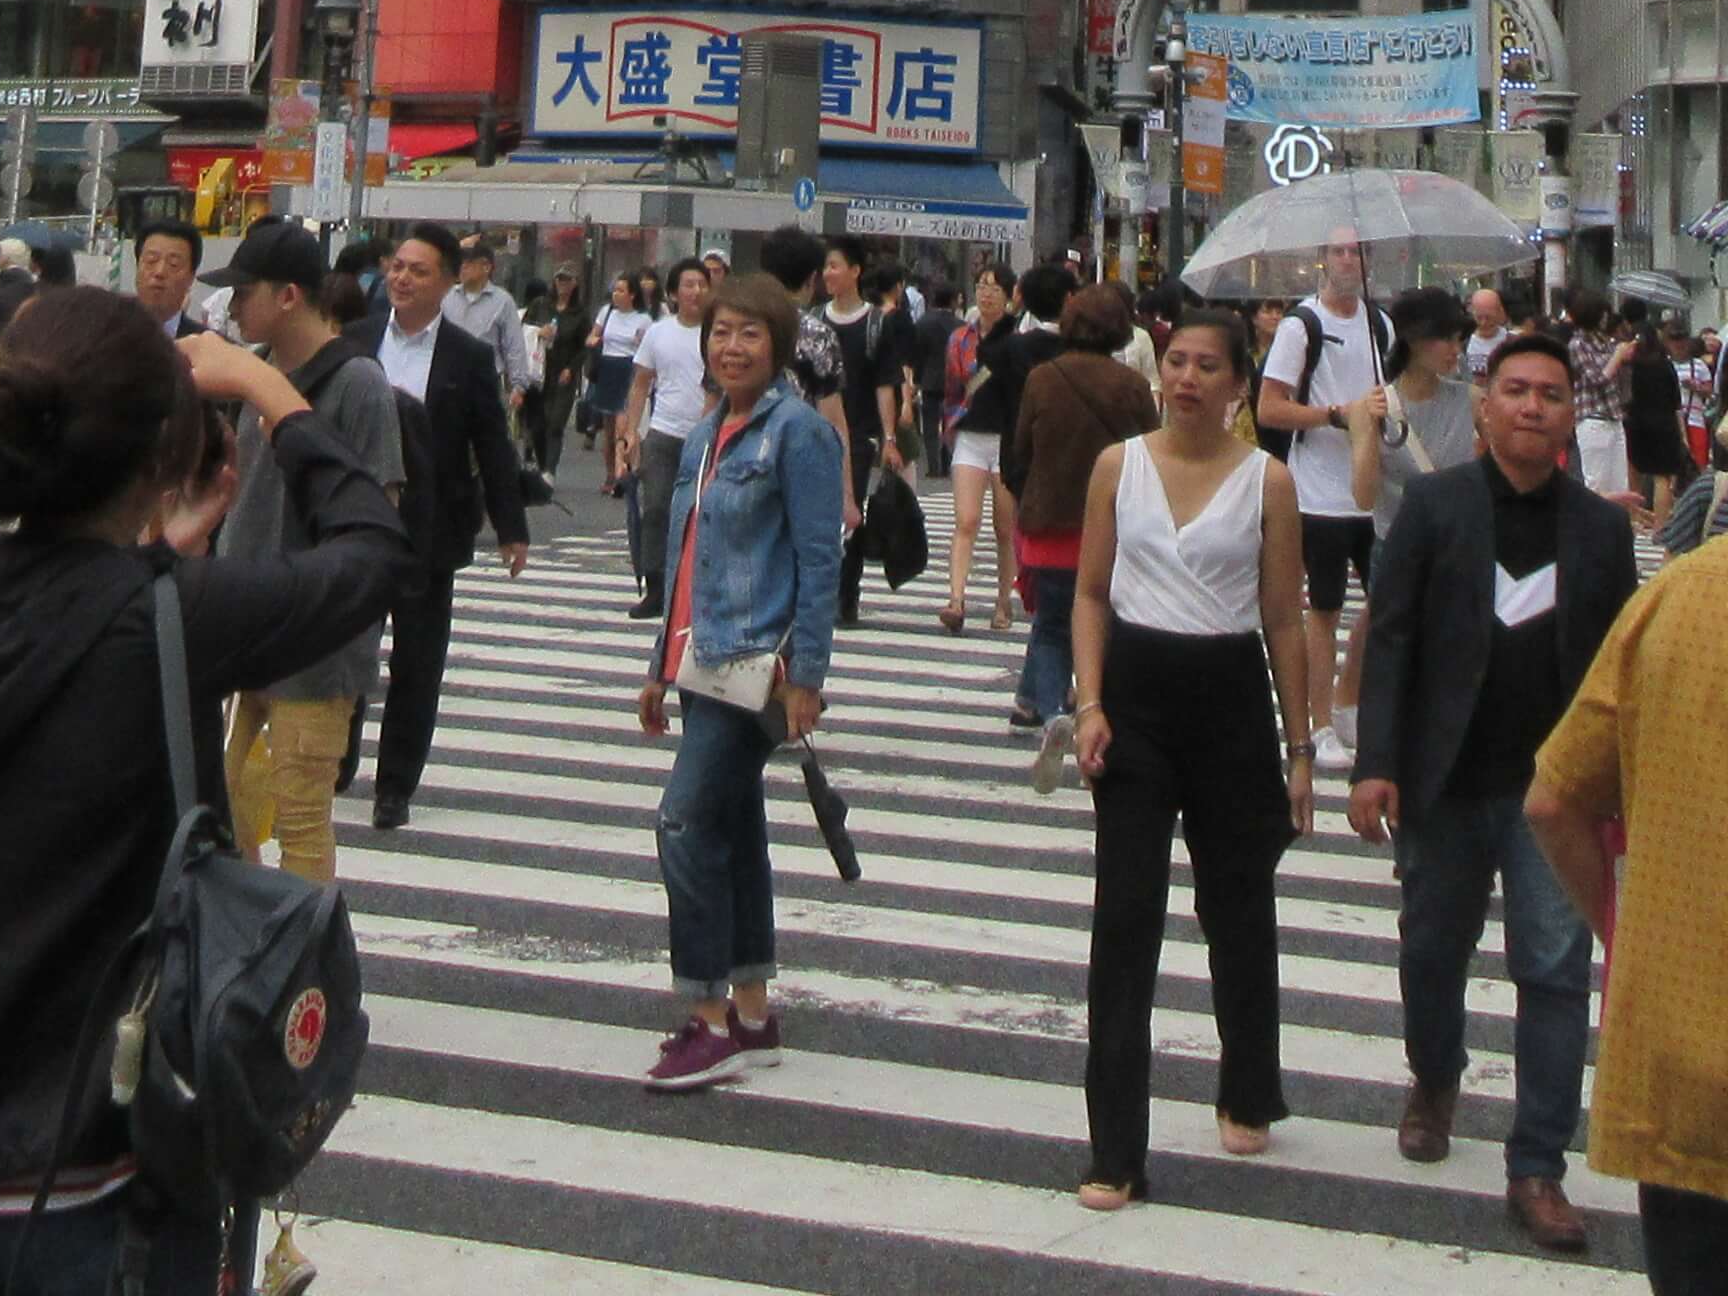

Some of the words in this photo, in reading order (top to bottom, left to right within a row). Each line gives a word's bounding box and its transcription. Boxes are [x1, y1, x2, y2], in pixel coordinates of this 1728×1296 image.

[551, 31, 959, 123] 大盛堂書店
[51, 84, 141, 108] フルーツパーラ
[885, 126, 920, 140] BOOKS
[924, 128, 970, 142] TAISEIDO
[849, 197, 926, 212] TAISEIDO
